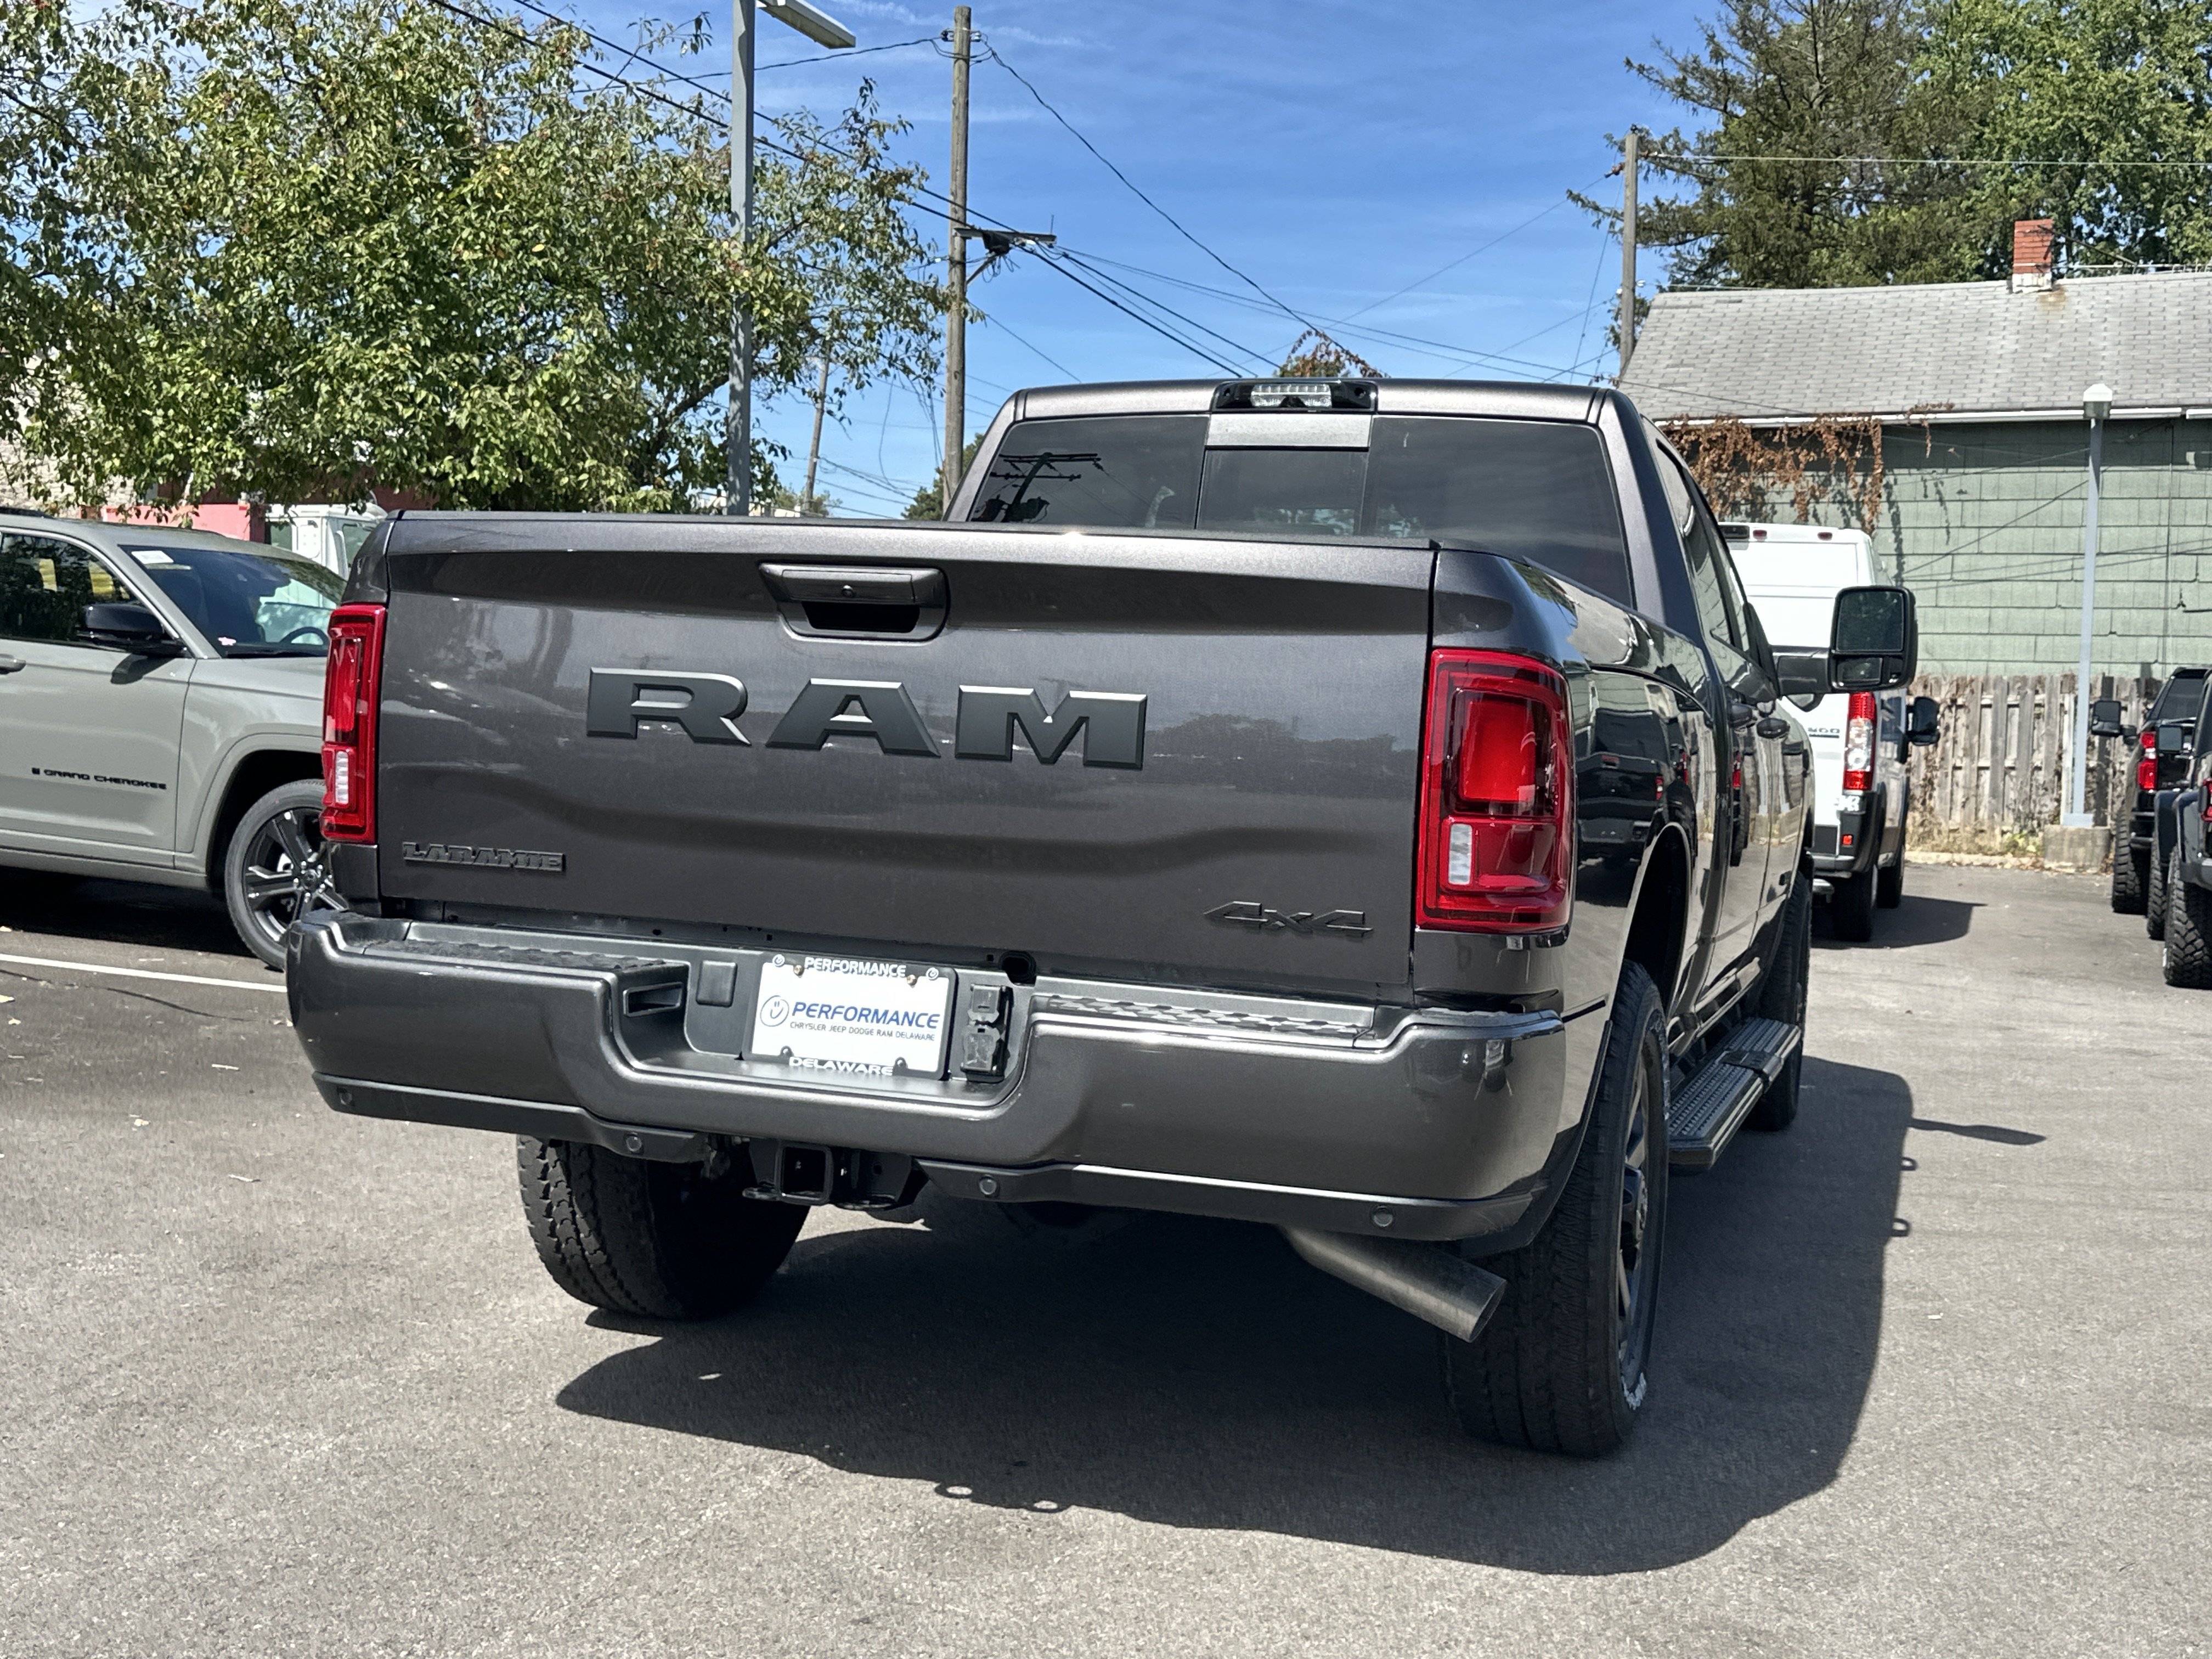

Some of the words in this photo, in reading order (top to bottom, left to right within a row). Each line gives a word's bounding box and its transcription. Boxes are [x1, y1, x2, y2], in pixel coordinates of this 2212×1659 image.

[586, 666, 1147, 771] RAM
[43, 769, 91, 781] GRAND
[94, 775, 167, 790] CHEROKEE
[402, 841, 566, 872] LARAMIE
[805, 957, 906, 977] PERFORMANCE
[792, 1002, 940, 1029] PERFORMANCE
[790, 1022, 826, 1031] CHRYSLER
[829, 1024, 846, 1032] JEEP
[849, 1026, 874, 1036] DODGE
[895, 1031, 935, 1041] DELAWARE
[789, 1057, 893, 1075] DELAWARE
